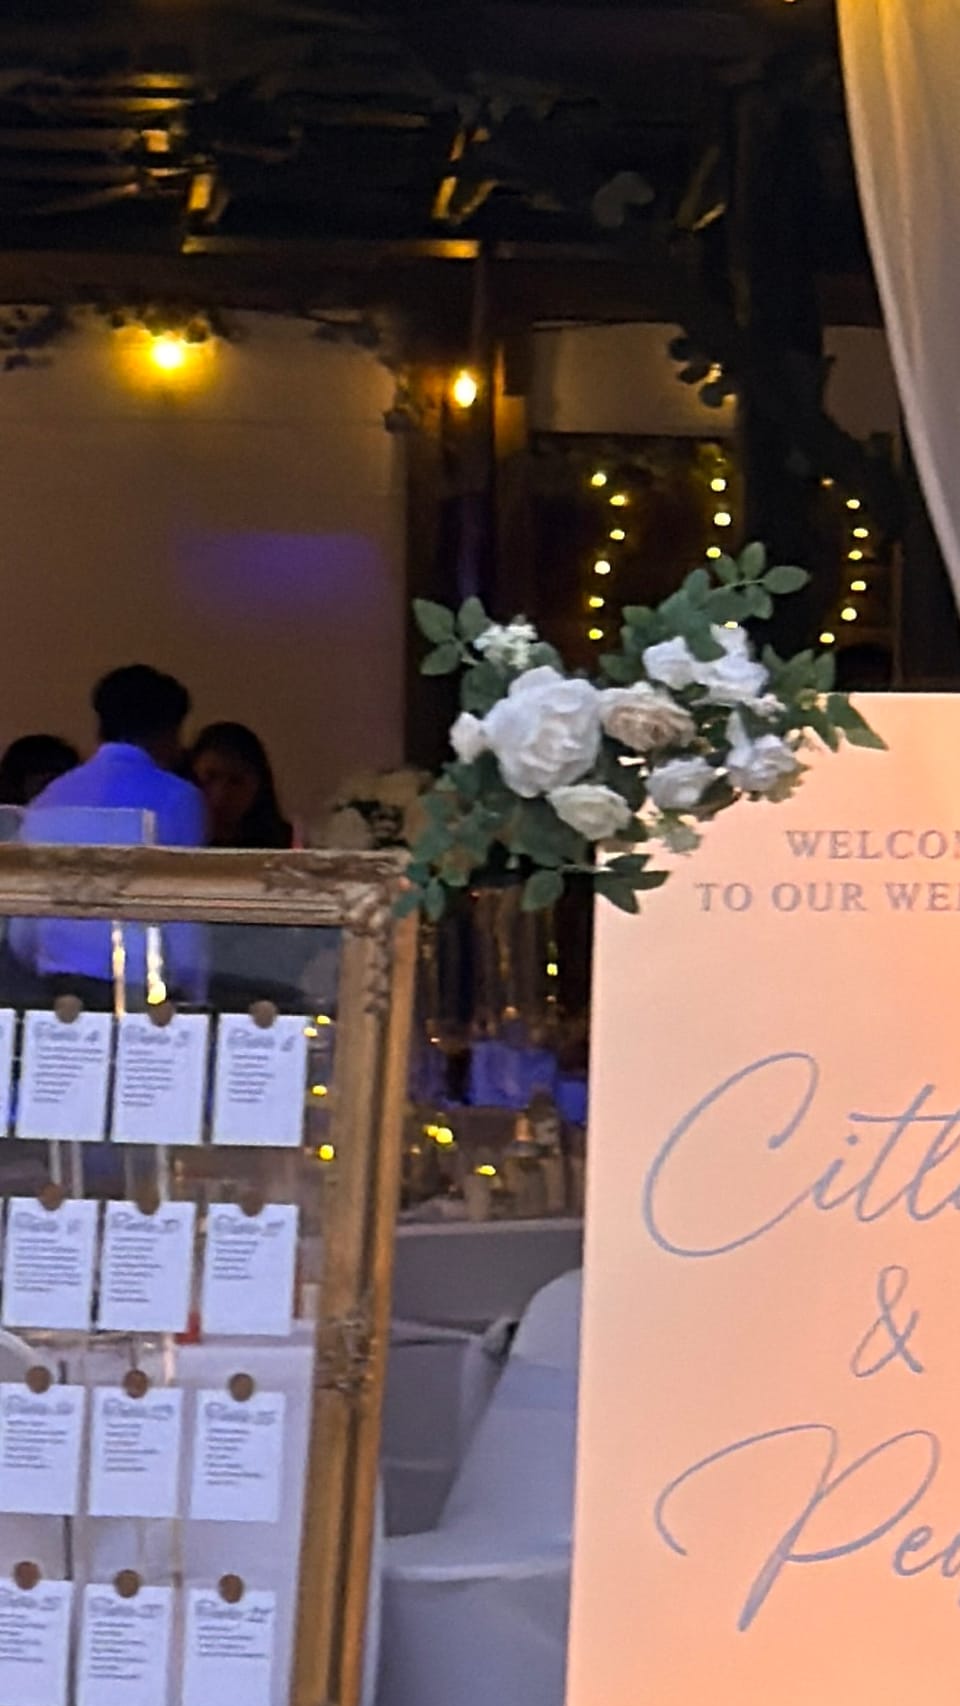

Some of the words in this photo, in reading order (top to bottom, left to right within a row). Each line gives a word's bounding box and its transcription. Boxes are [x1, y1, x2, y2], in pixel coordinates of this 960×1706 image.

[694, 882, 754, 912] TO
[771, 881, 868, 912] OUR
[849, 1264, 924, 1378] &
